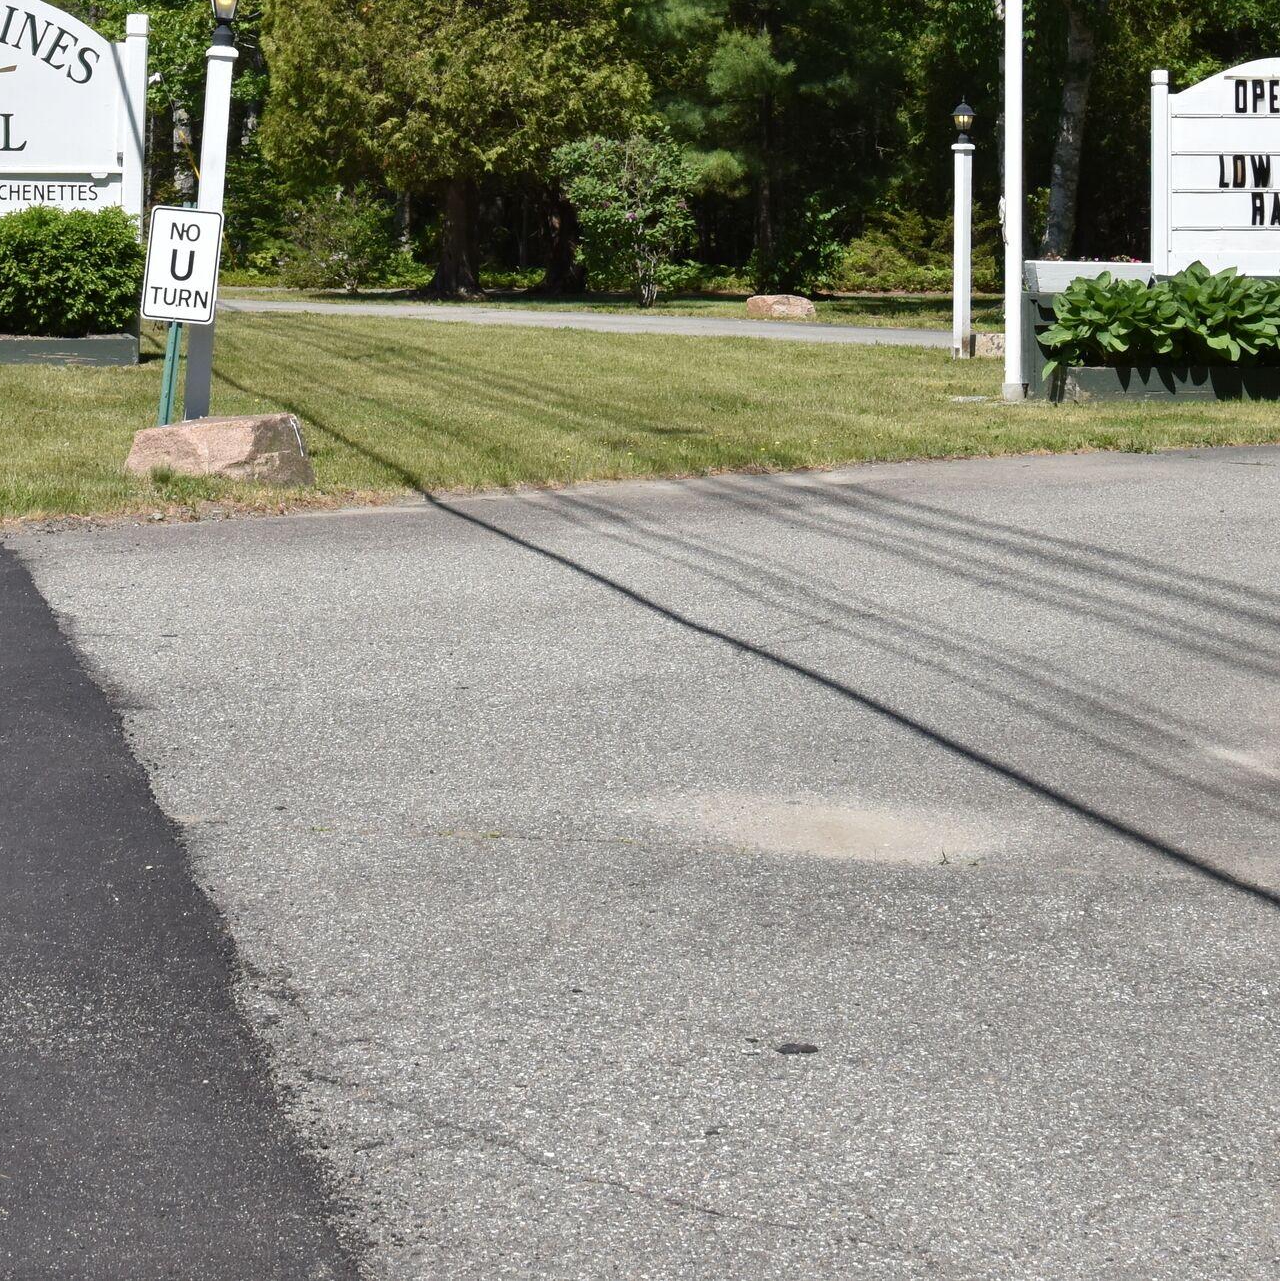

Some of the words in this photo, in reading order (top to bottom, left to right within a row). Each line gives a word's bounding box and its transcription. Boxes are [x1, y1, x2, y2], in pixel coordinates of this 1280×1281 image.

[1219, 154, 1271, 188] LOW
[170, 222, 201, 242] NO
[170, 248, 195, 281] U
[150, 286, 209, 309] TURN
